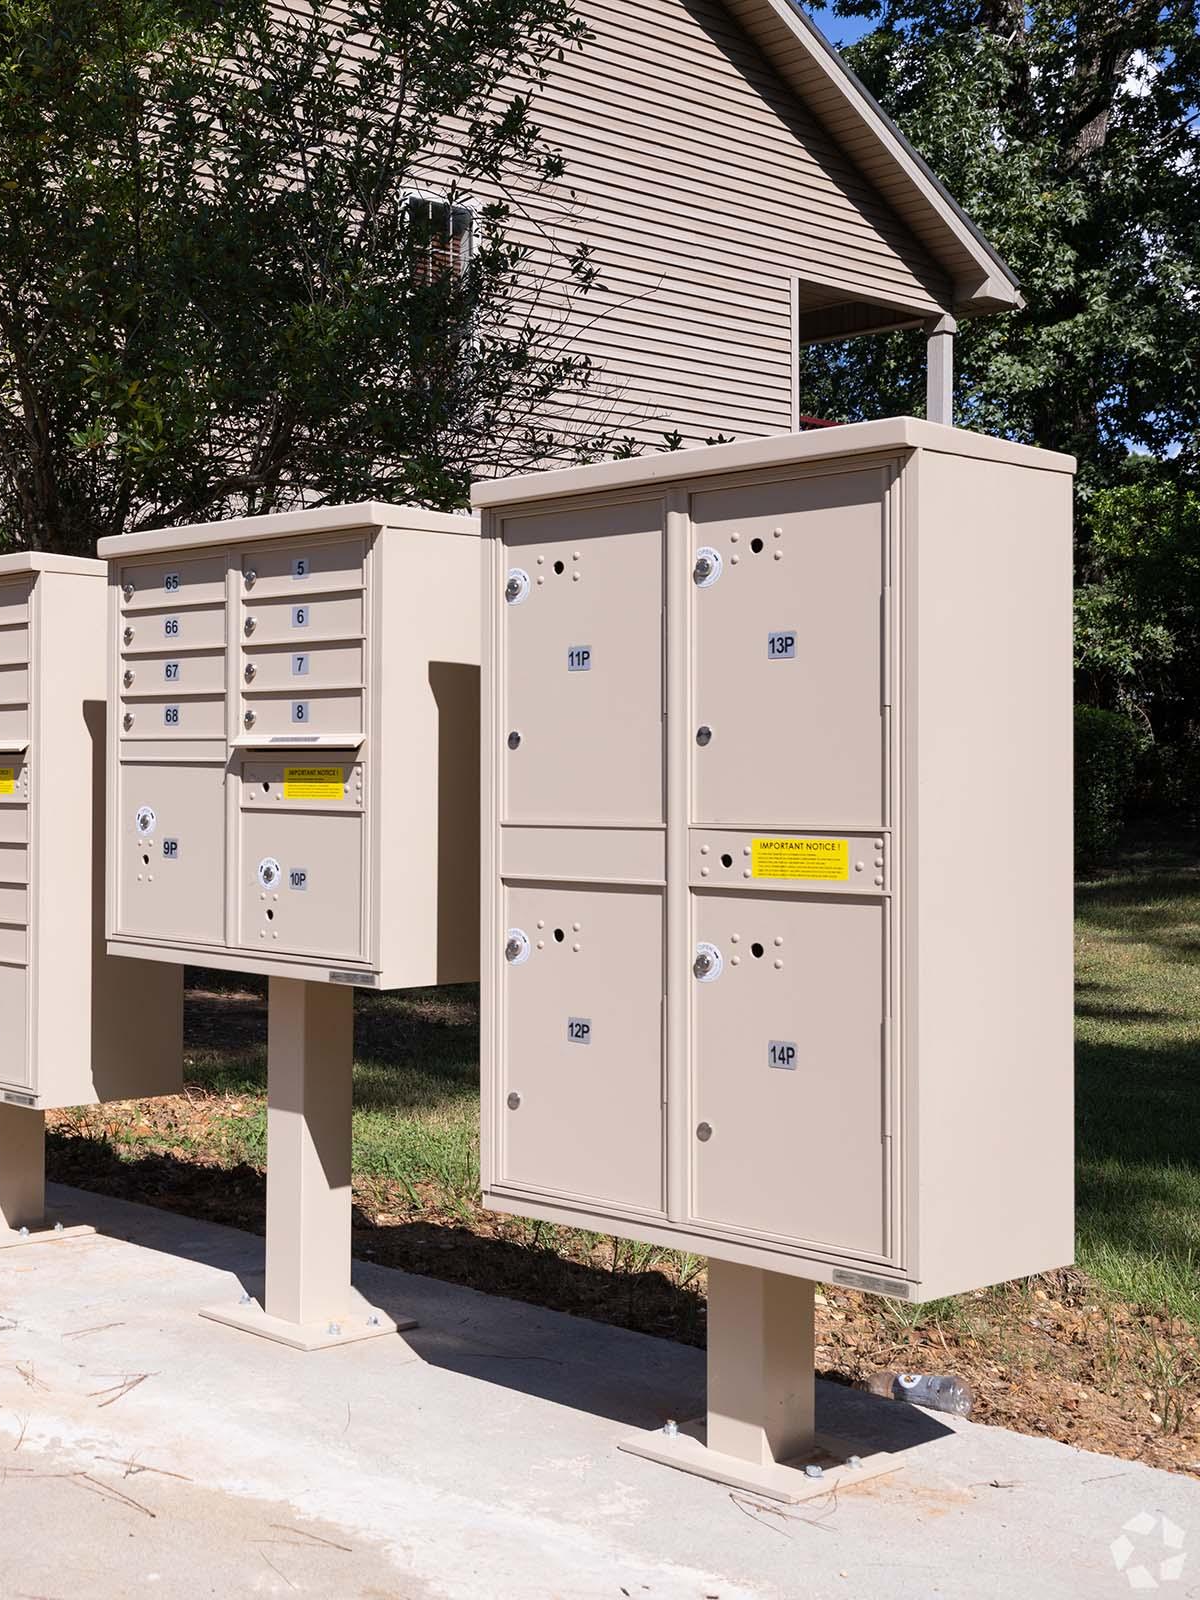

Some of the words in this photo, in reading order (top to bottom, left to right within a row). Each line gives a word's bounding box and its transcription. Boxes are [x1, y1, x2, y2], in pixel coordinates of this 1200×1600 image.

[297, 561, 304, 576] 5
[165, 576, 178, 590] 65
[297, 609, 304, 624] 6
[165, 620, 178, 634] 66
[769, 636, 794, 654] 13P
[297, 657, 304, 672] 7
[568, 651, 590, 667] 11P
[165, 664, 179, 678] 67
[165, 709, 178, 722] 68
[296, 705, 304, 720] 8
[163, 841, 178, 855] 9P
[290, 872, 306, 886] 10P
[568, 1022, 590, 1039] 12P
[770, 1046, 795, 1065] 14P
